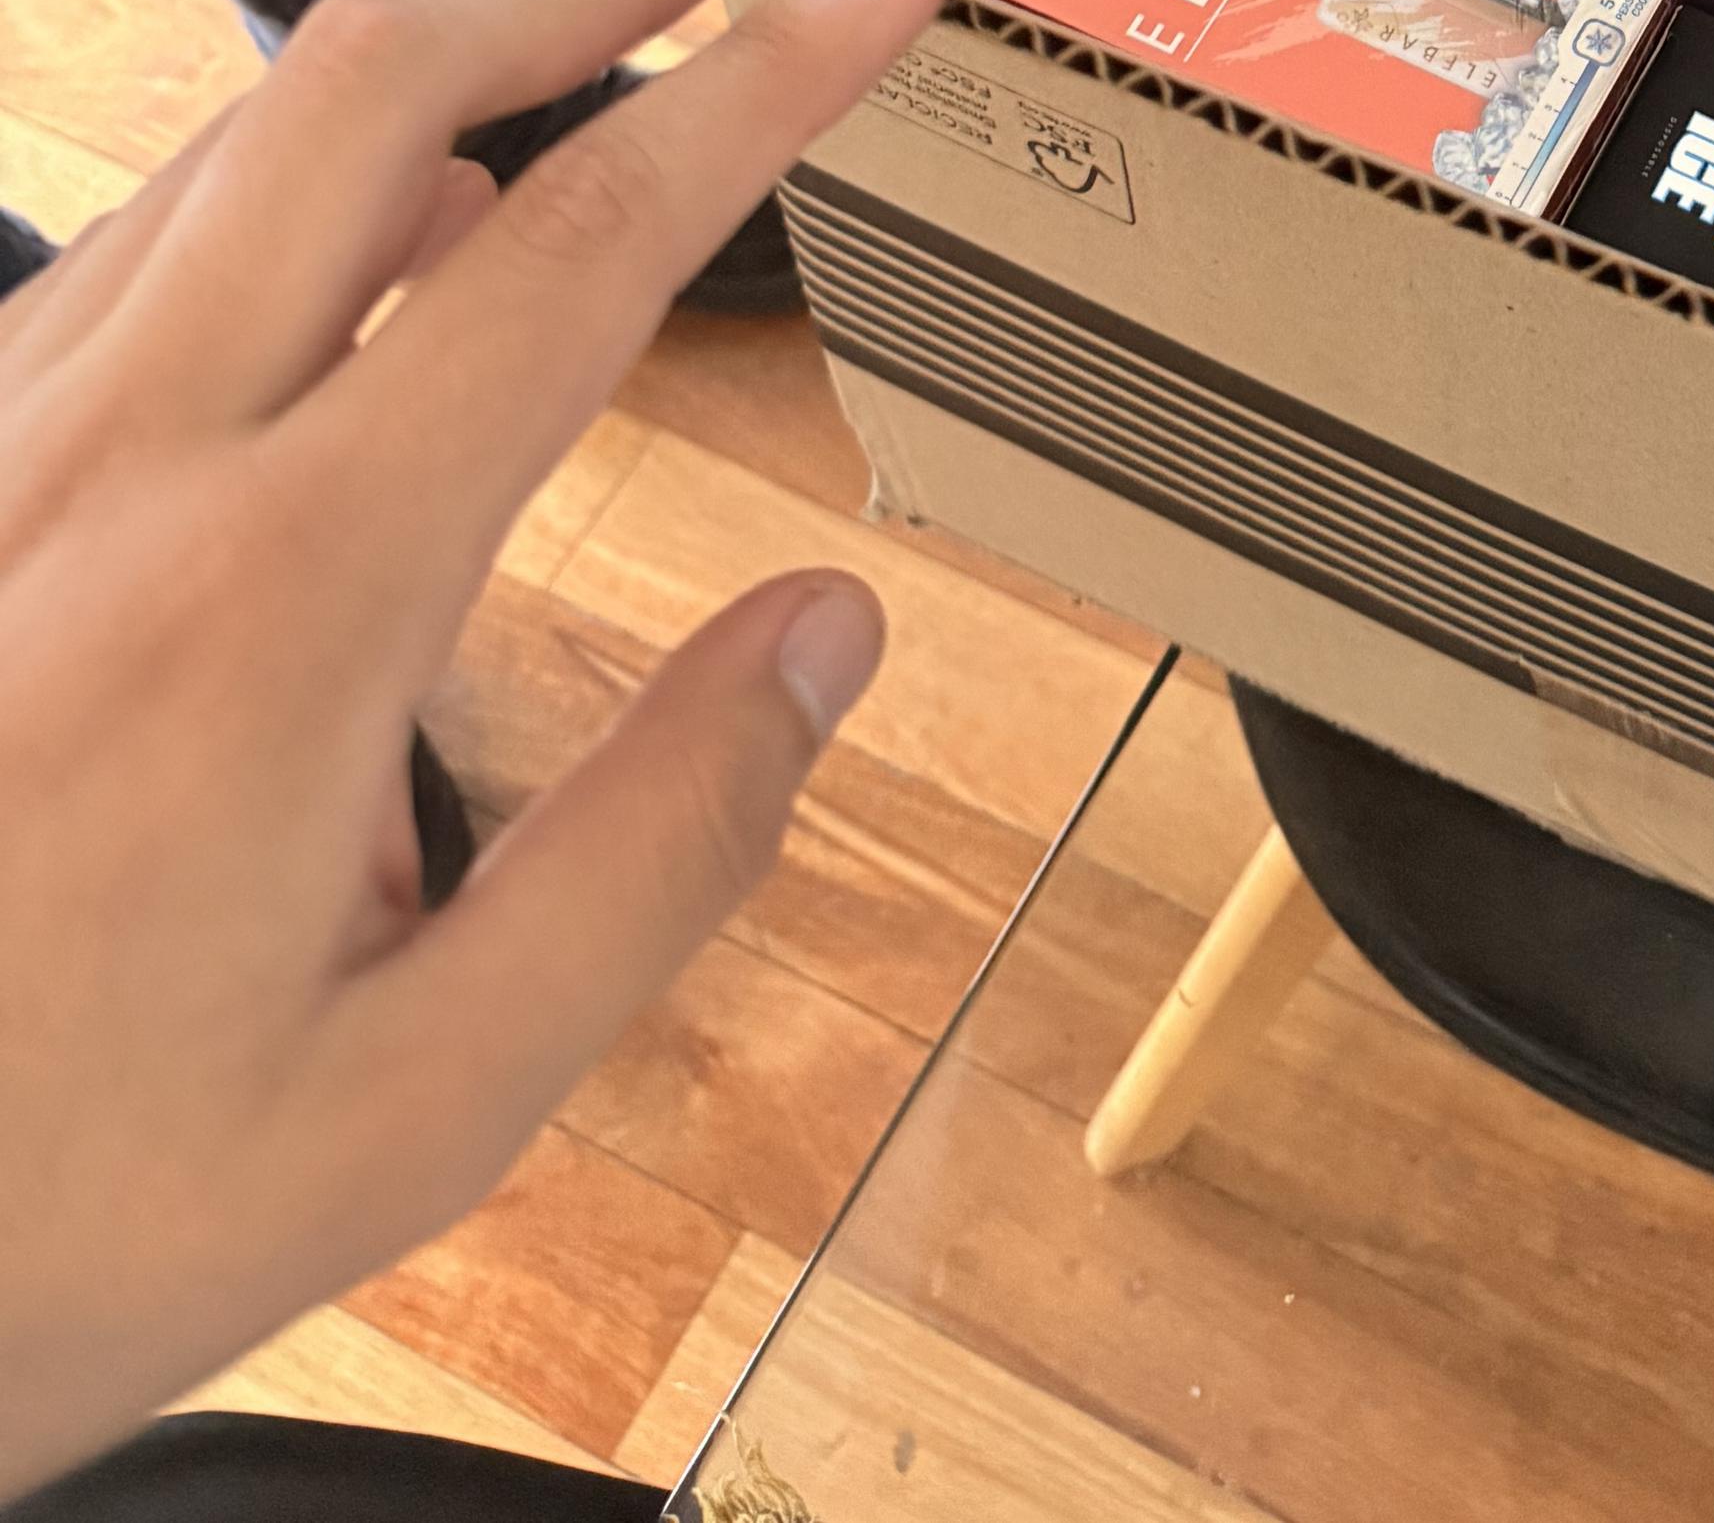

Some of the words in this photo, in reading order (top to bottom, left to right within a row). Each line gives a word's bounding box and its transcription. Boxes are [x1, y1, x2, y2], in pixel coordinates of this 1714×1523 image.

[1379, 24, 1497, 90] ELFBAR
[1024, 121, 1096, 156] FSC
[1642, 115, 1679, 179] DISPOSABLE
